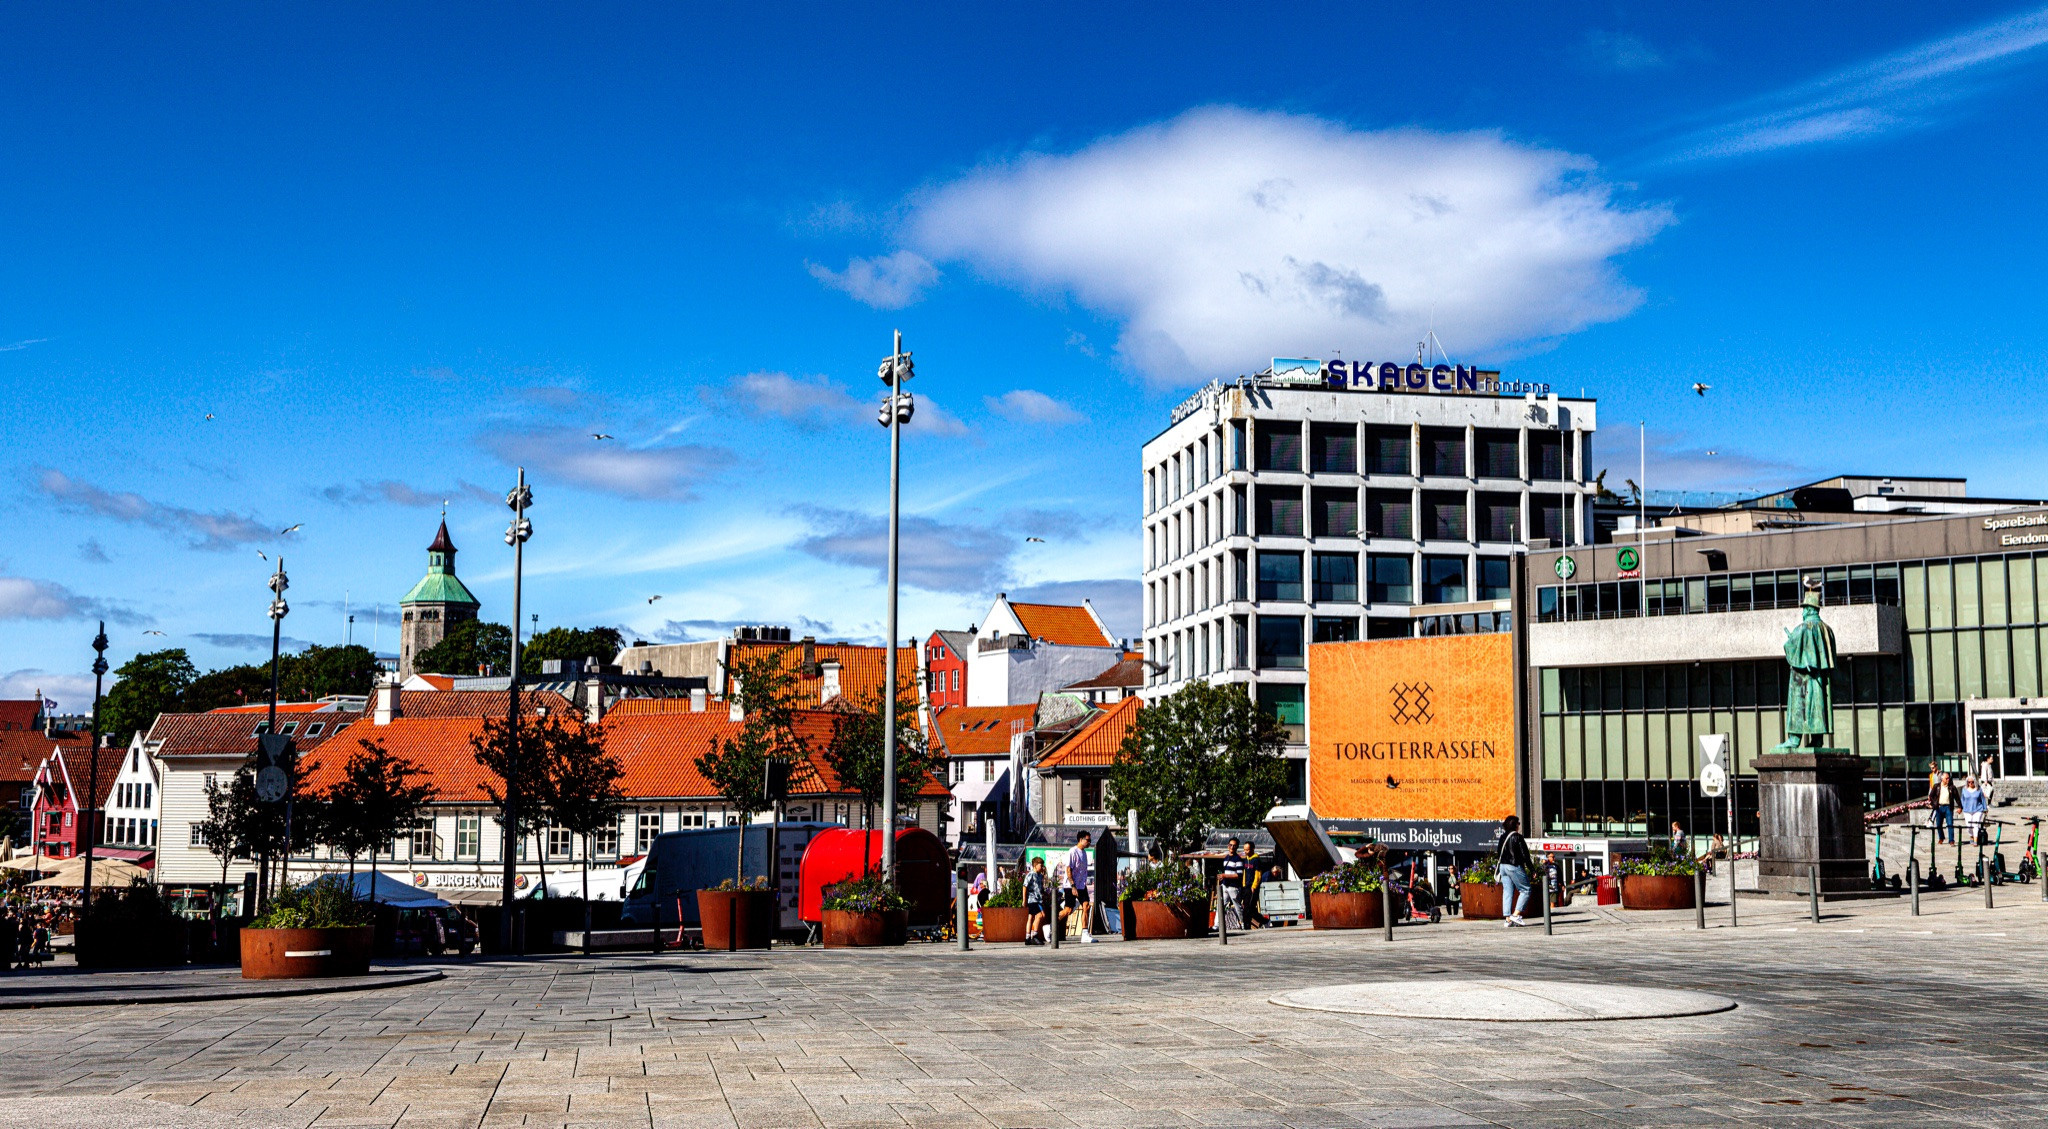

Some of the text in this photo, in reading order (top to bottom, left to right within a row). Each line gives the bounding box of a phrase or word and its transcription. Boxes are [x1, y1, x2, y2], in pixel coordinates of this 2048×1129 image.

[1327, 359, 1551, 394] SKAGEN fondene
[1984, 514, 2048, 531] SpareBank
[1333, 740, 1496, 760] TORGTERRASSEN
[1367, 827, 1462, 847] Illums Bolighus
[1549, 843, 1574, 851] SPAR
[435, 874, 479, 888] BURGER
